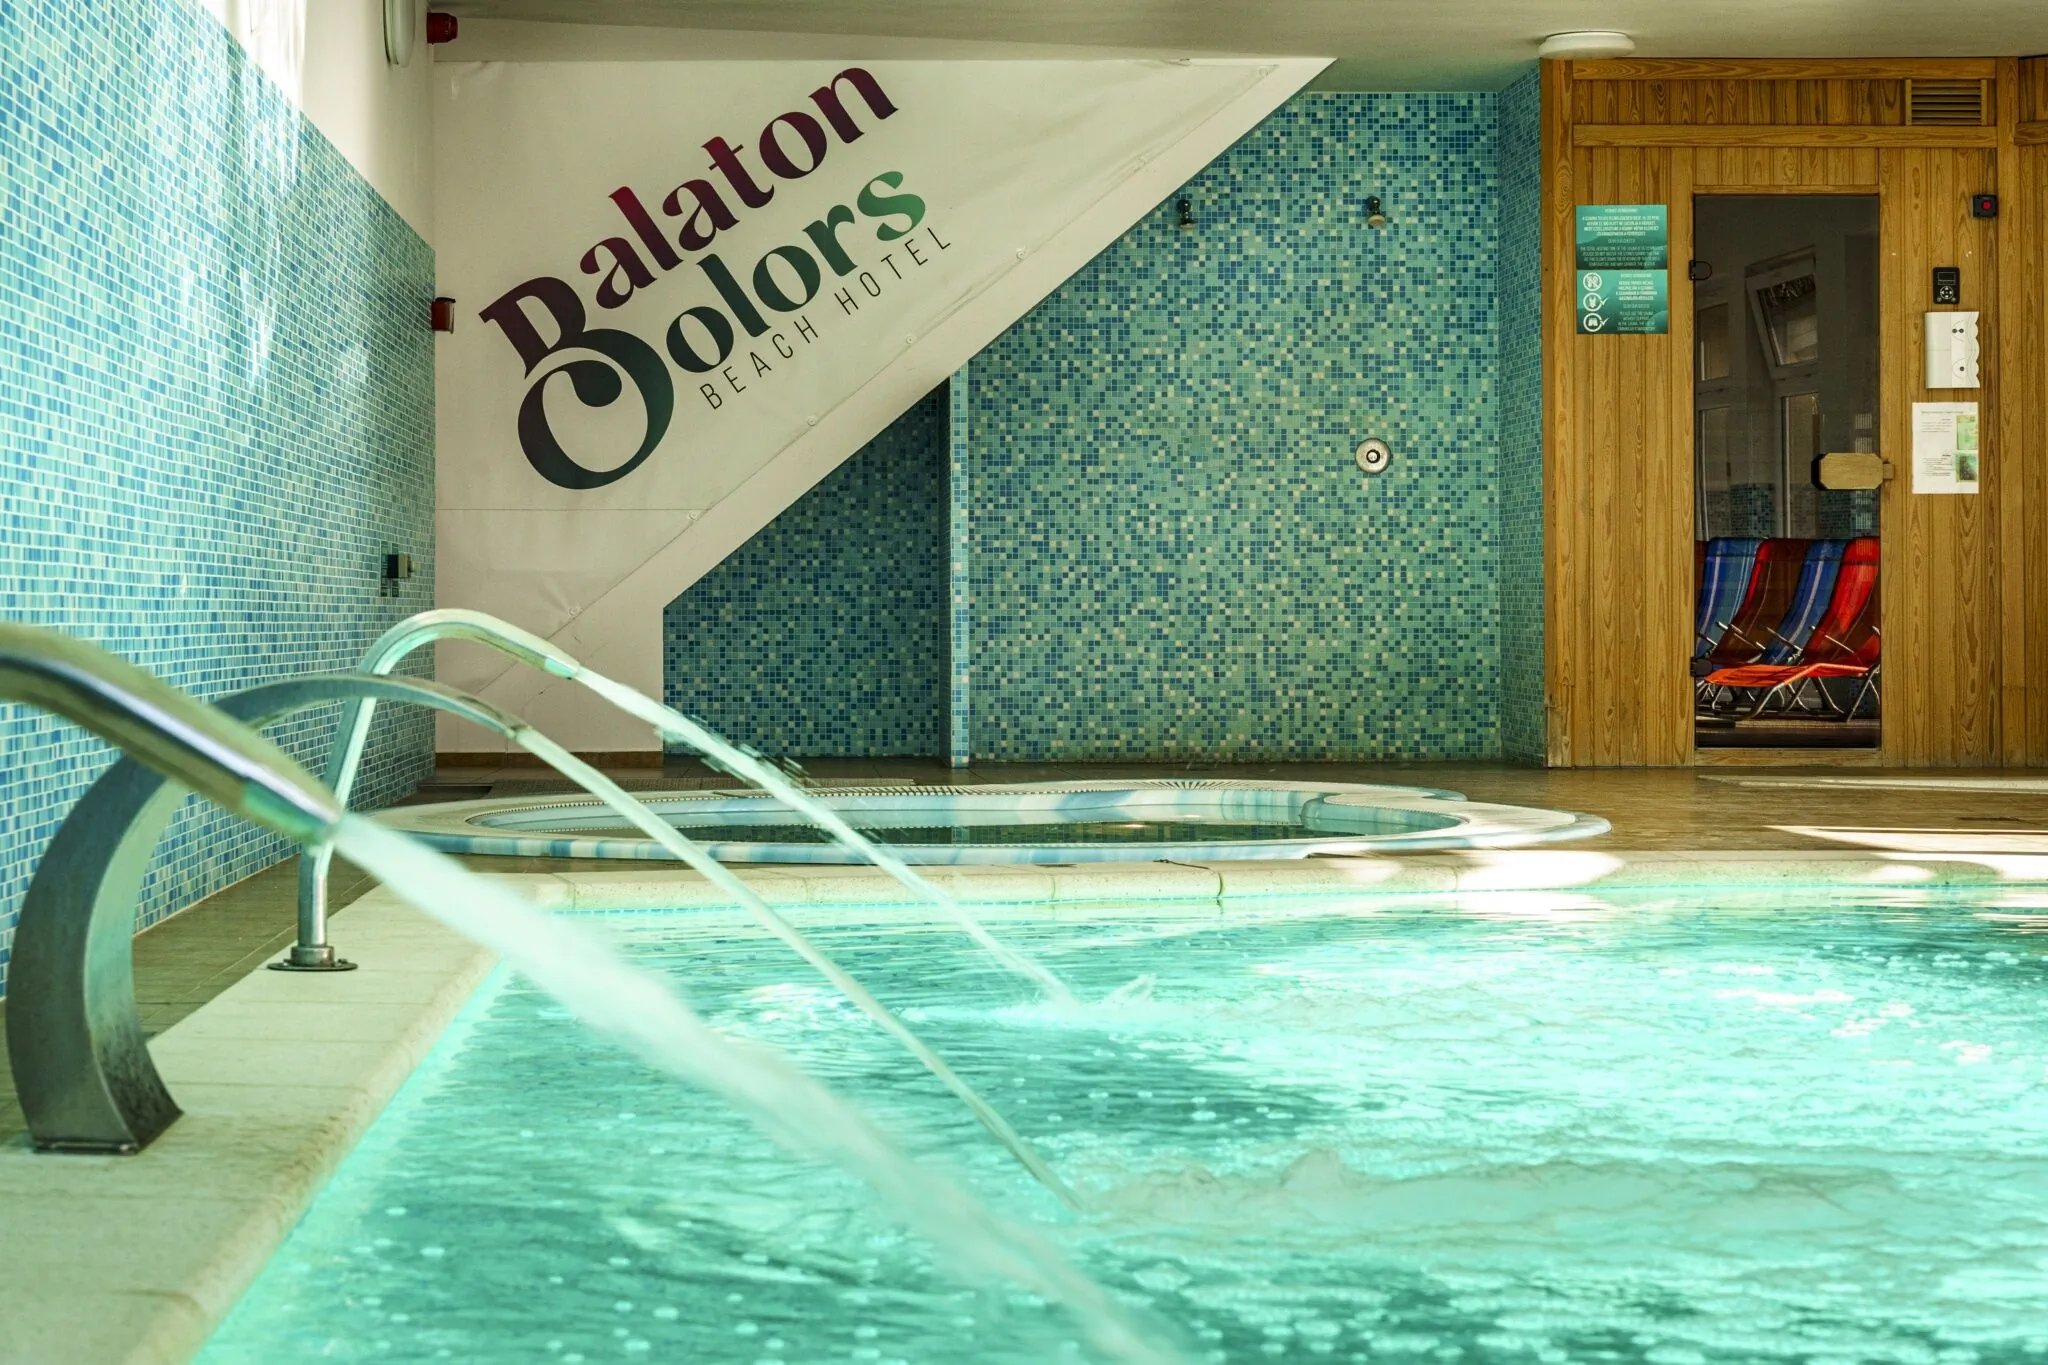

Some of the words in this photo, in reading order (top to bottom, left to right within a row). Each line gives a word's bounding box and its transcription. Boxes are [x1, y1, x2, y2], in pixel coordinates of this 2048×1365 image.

[478, 67, 899, 380] Balaton
[700, 315, 819, 410] BEACH
[834, 226, 952, 316] HOTEL
